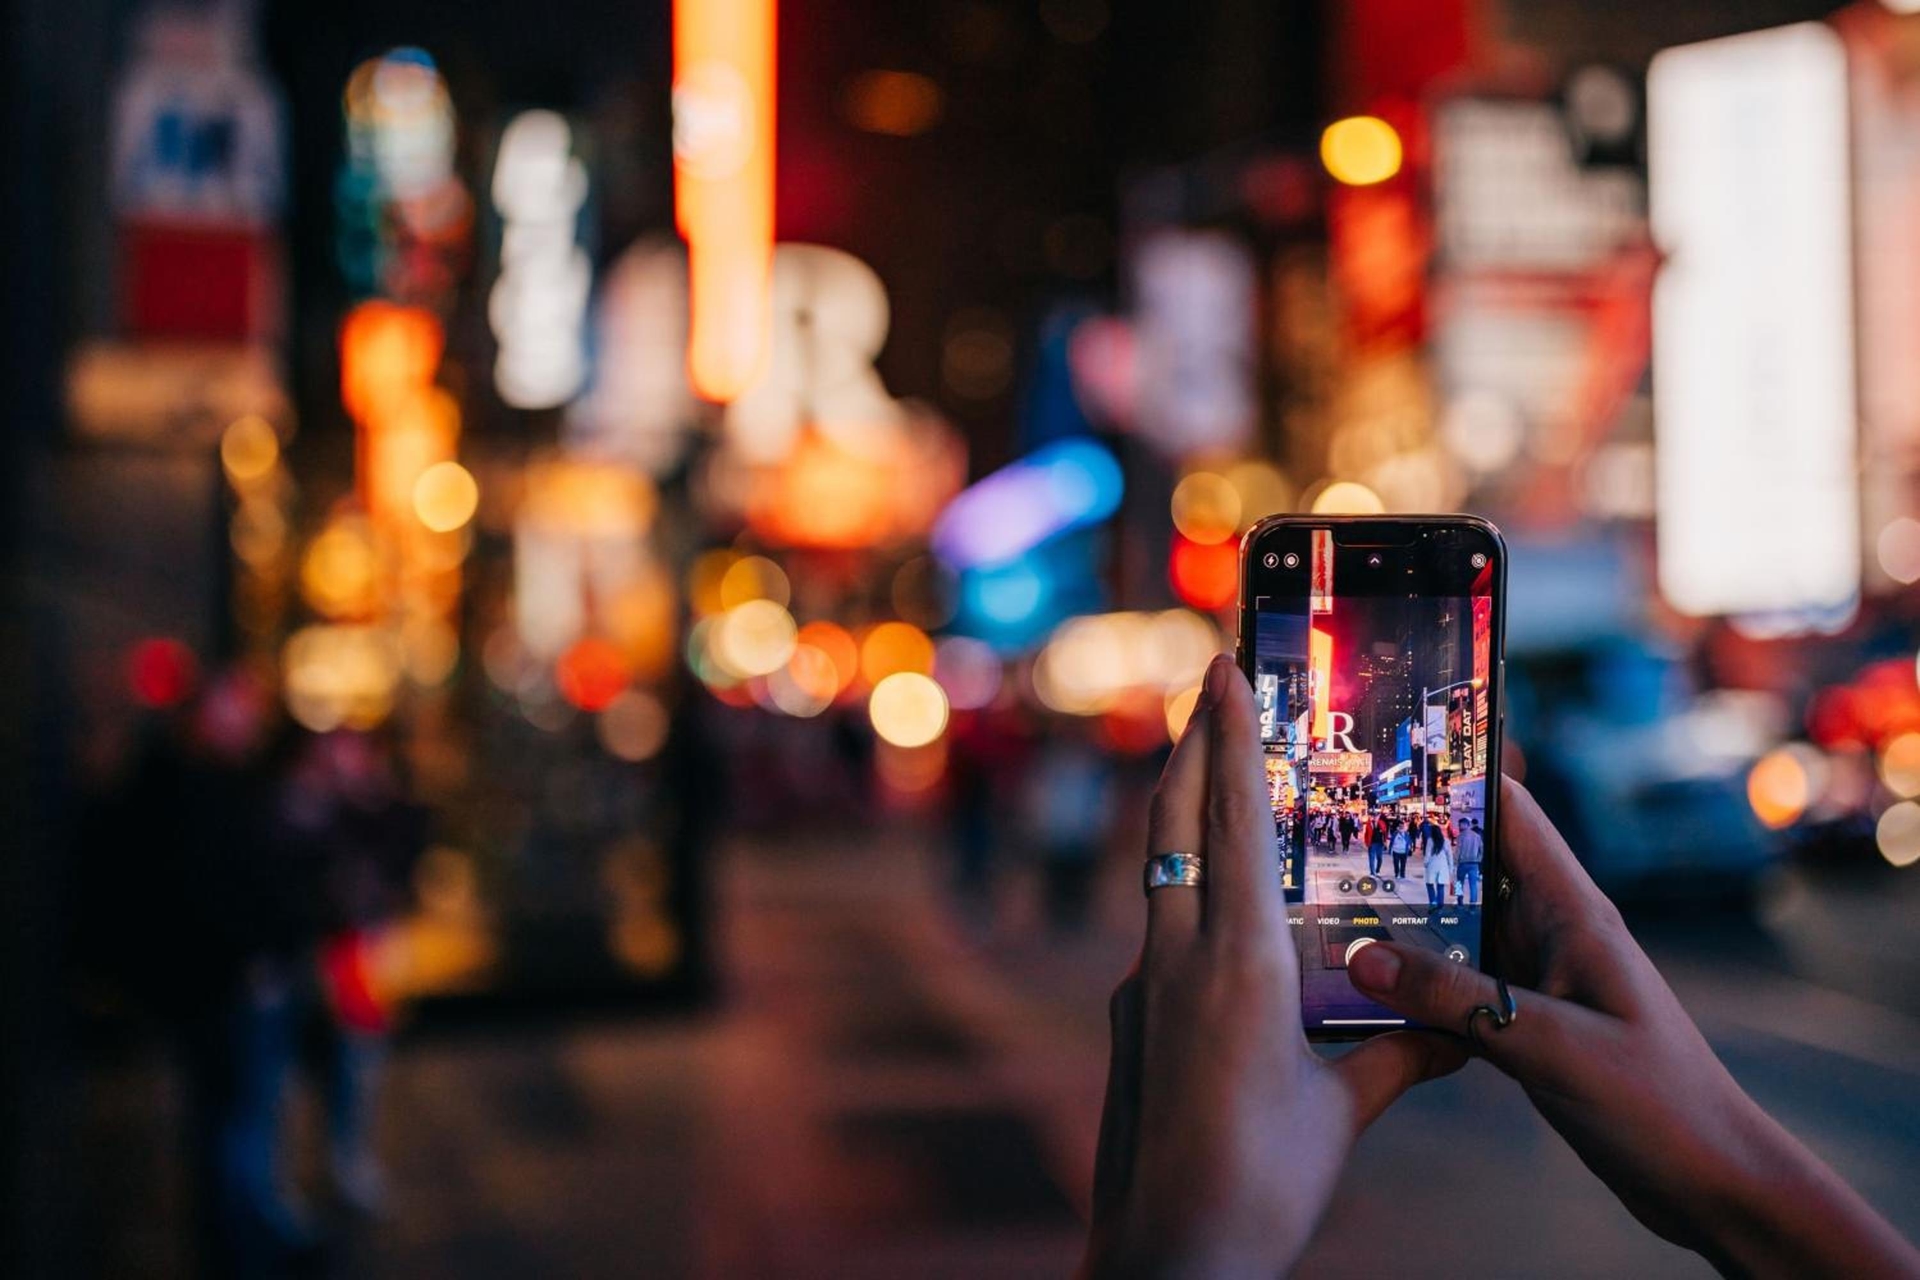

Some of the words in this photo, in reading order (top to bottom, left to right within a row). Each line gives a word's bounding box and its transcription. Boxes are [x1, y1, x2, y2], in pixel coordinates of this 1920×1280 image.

[1321, 711, 1368, 753] R
[1462, 708, 1472, 737] DAT
[1463, 741, 1472, 769] SAY
[1286, 917, 1304, 925] ATIC
[1317, 917, 1340, 925] VIDEO
[1353, 917, 1379, 925] PHOTO
[1392, 917, 1428, 925] PORTRAIT
[1440, 917, 1459, 925] PANO
